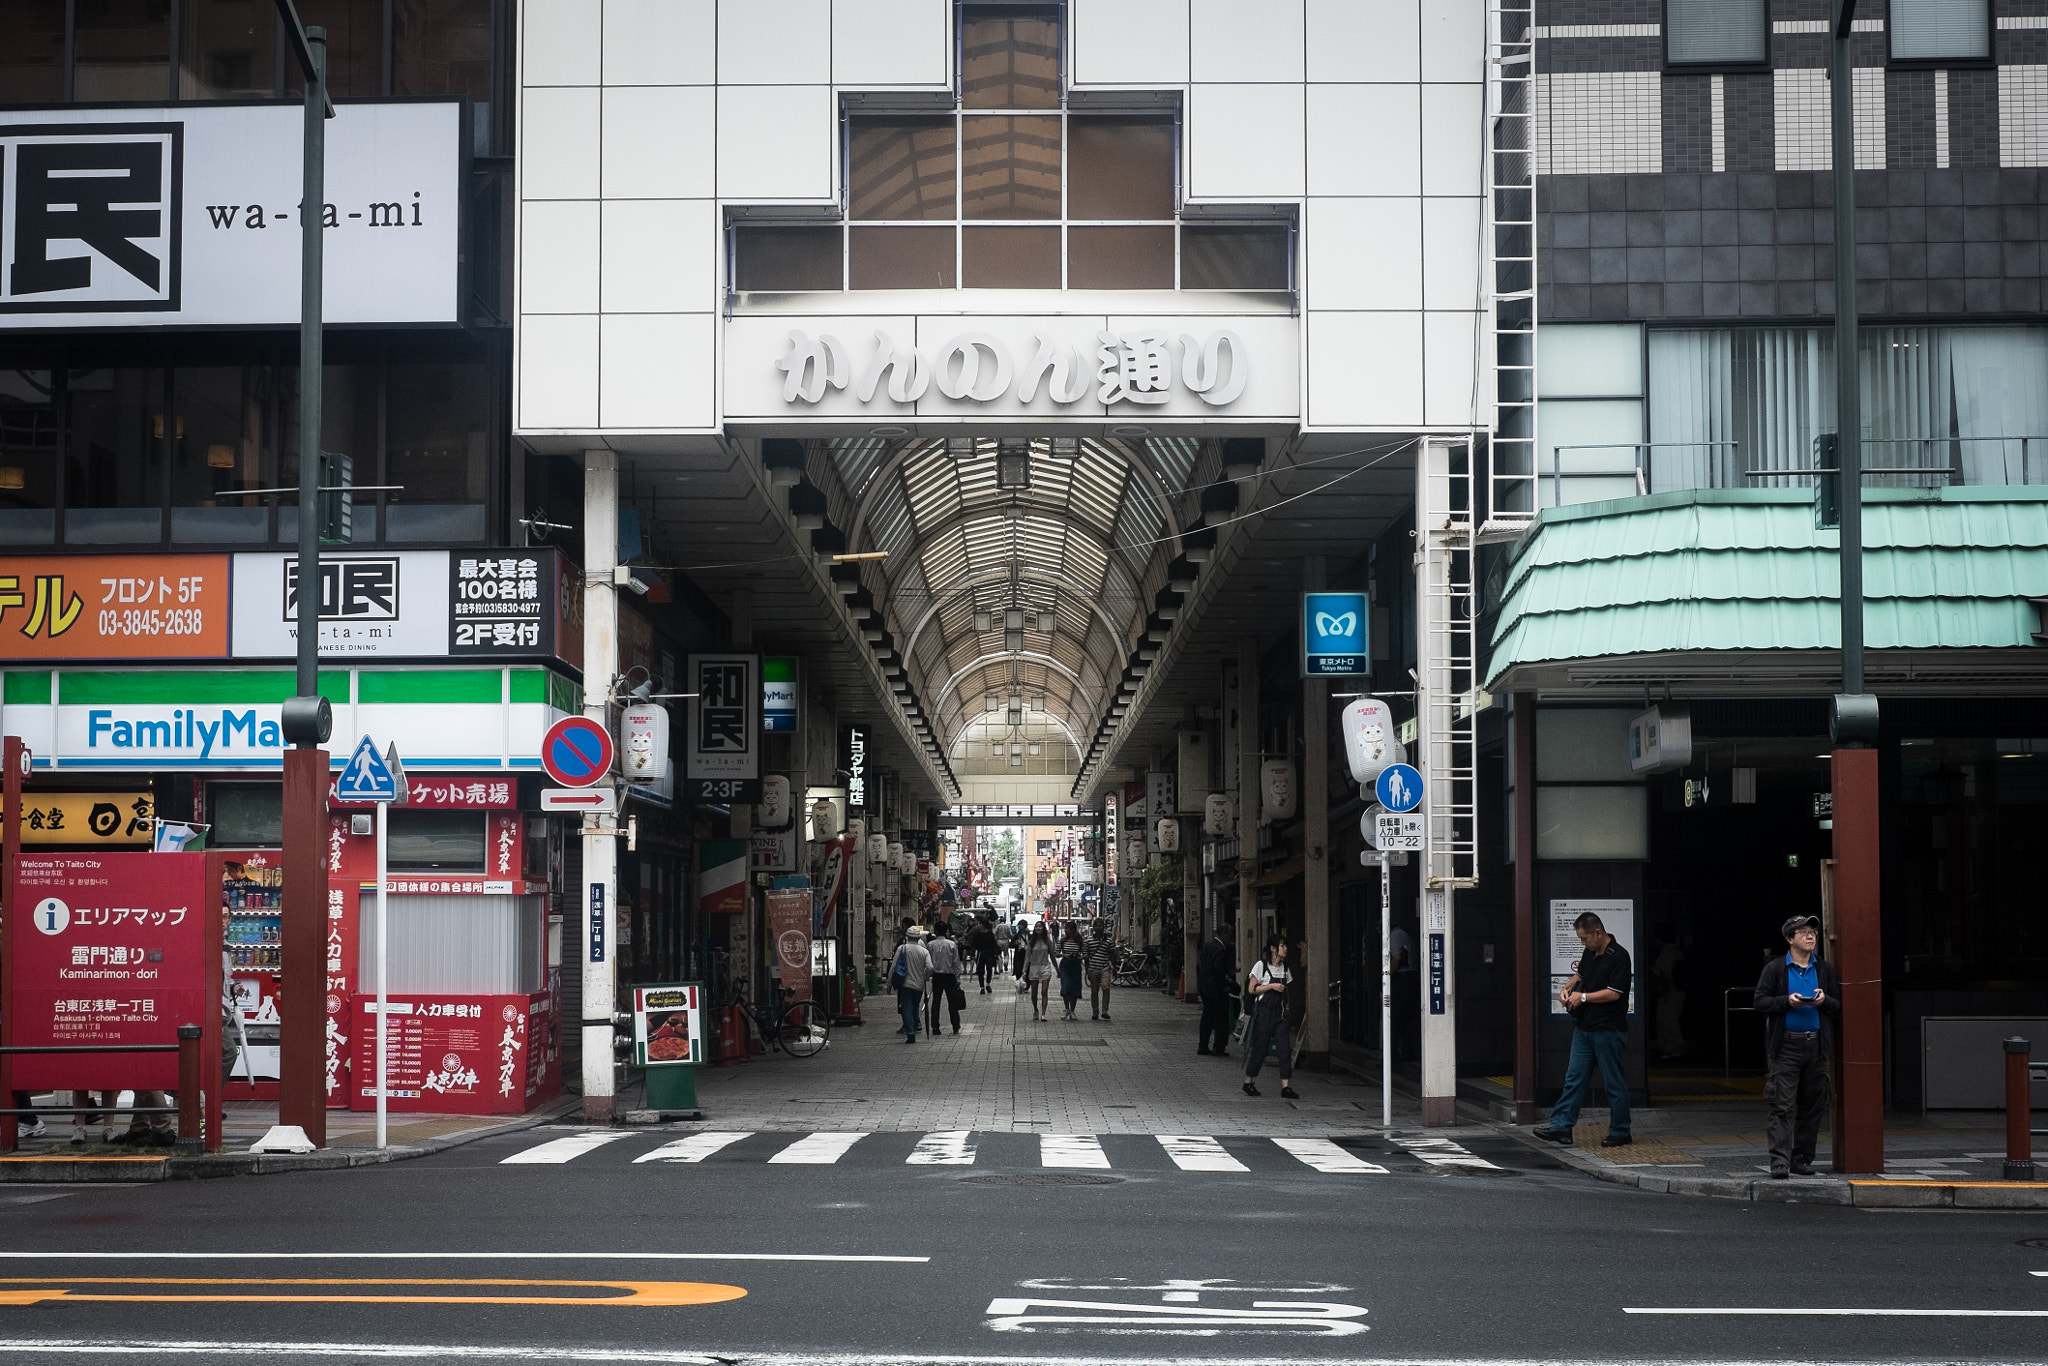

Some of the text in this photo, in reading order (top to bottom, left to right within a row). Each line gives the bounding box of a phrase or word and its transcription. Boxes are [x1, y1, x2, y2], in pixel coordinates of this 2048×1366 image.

[0, 142, 162, 295] 民
[775, 328, 1249, 407] かんのん通り
[459, 558, 538, 579] 最大宴会
[100, 577, 203, 603] フロント 5F
[458, 579, 538, 600] 100名様
[99, 609, 202, 635] 03-3845-2638
[289, 625, 392, 638] w-ta-mi
[455, 622, 540, 646] 2F受付
[1319, 658, 1354, 666] 東京メトロ
[701, 665, 744, 750] 和民
[88, 709, 290, 757] FamilyMa
[1380, 818, 1401, 827] 自転車
[1380, 827, 1401, 836] 人力車
[1404, 822, 1421, 831] を除く
[20, 860, 102, 870] Welcome To Taito City
[398, 882, 482, 893] 団体様の集合場所
[74, 906, 188, 926] エリアマップ
[71, 946, 145, 965] 雷門通り
[594, 948, 601, 957] 2
[54, 1000, 155, 1012] 台東区浅草一丁目
[415, 1003, 482, 1018] 人力車受付
[142, 1014, 158, 1022] City
[498, 1024, 522, 1099] 東京力車
[421, 1066, 480, 1094] 東京力車
